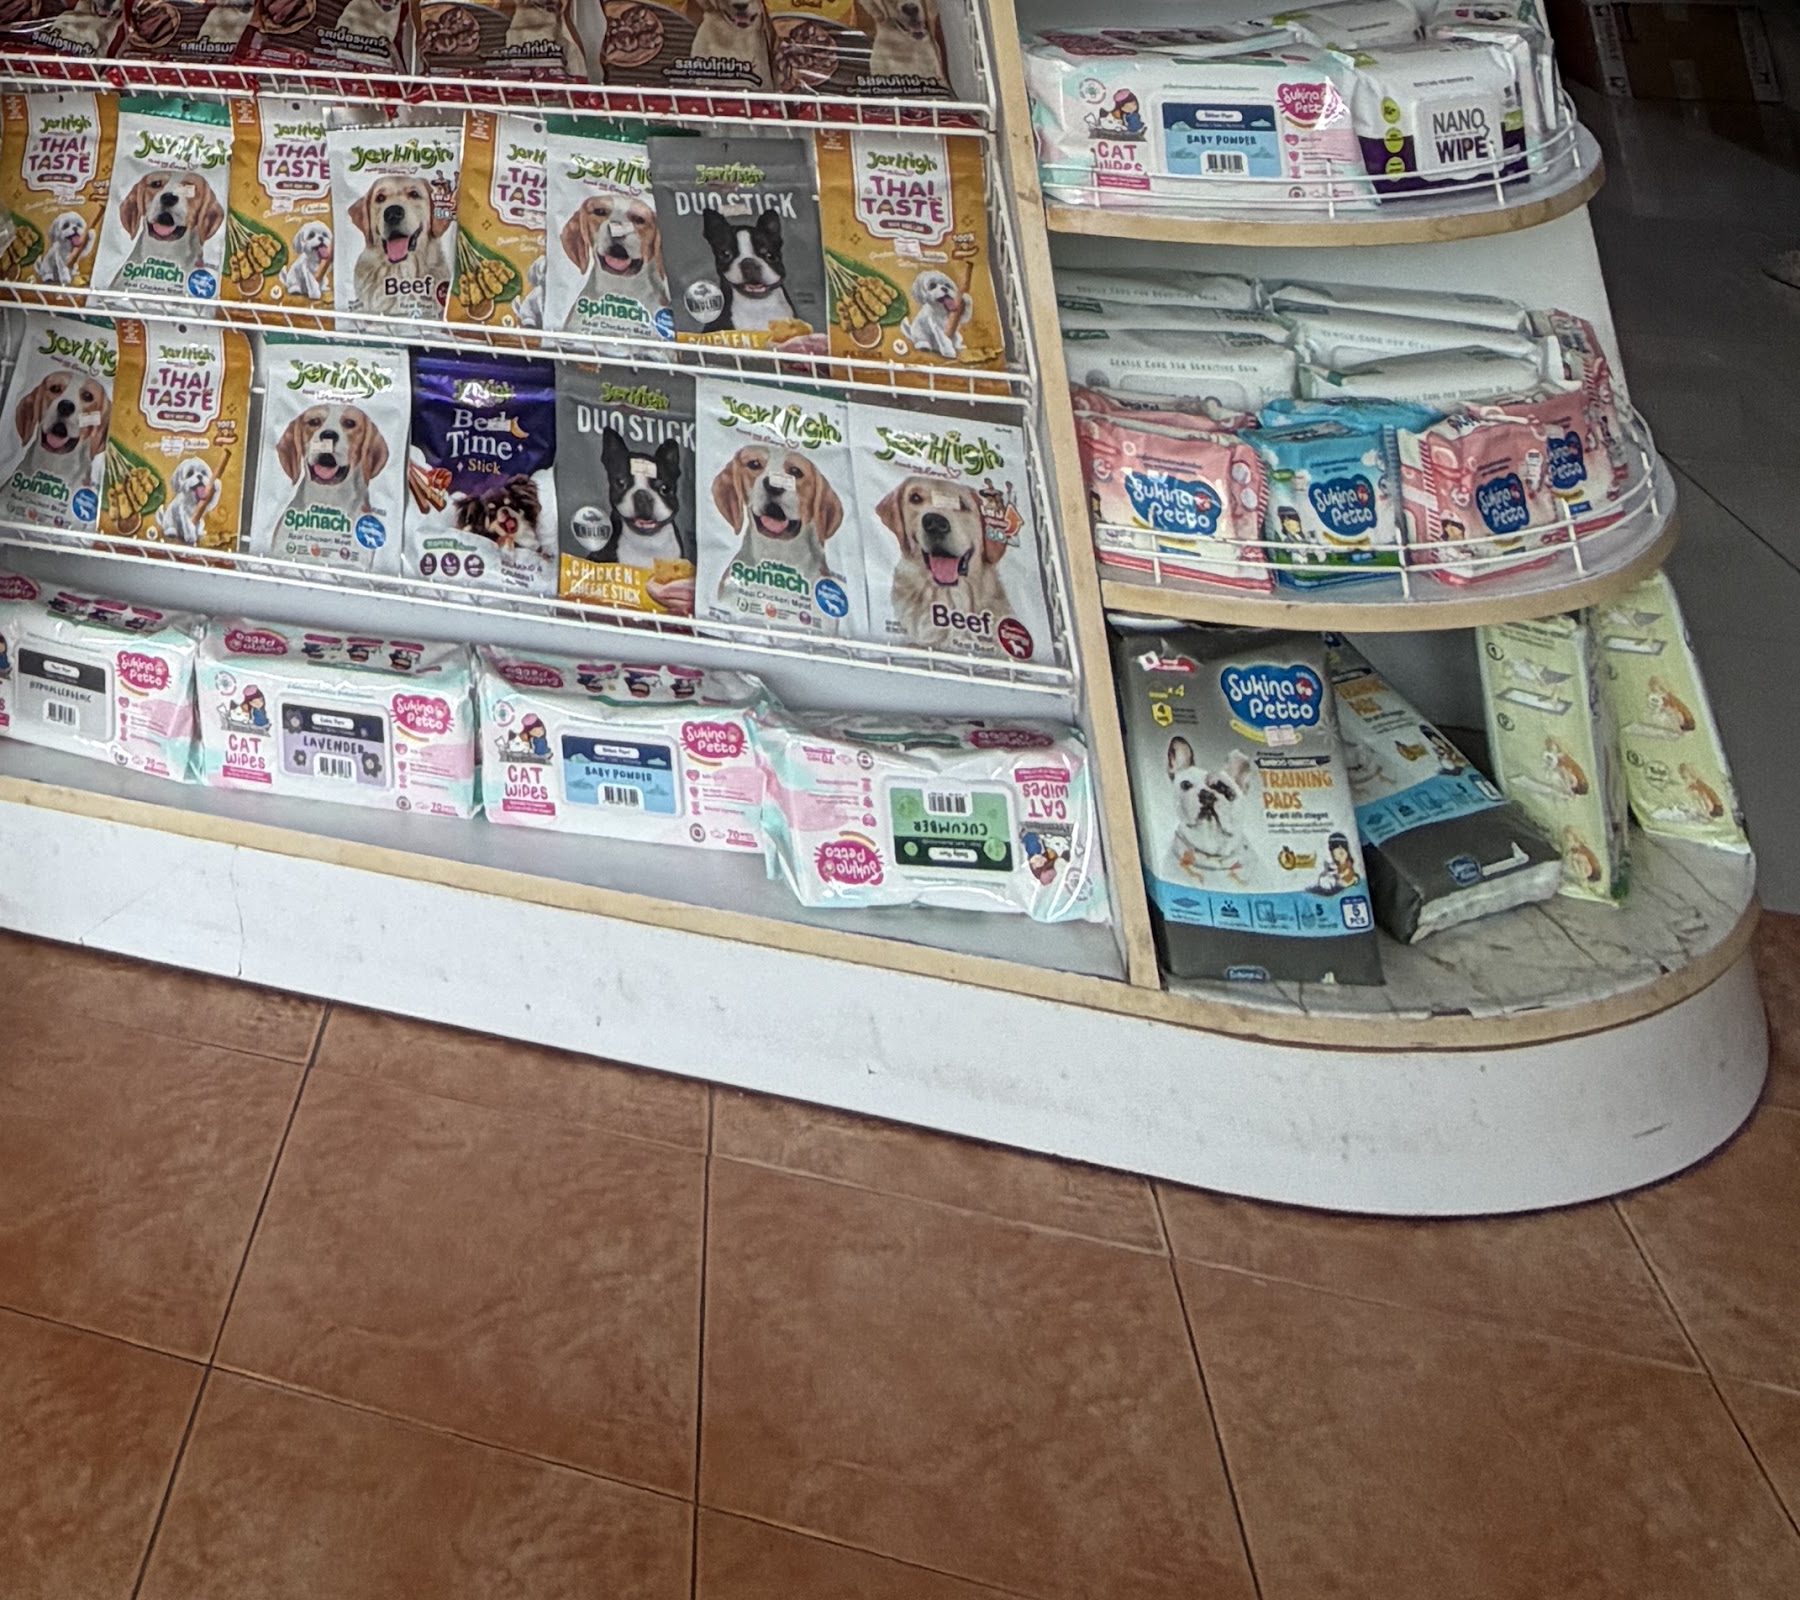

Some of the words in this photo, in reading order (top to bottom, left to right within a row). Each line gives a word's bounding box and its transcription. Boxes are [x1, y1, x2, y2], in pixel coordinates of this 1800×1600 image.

[1281, 87, 1322, 110] Sukina
[1432, 108, 1487, 135] NANO
[38, 137, 86, 154] THAI
[1097, 140, 1138, 161] CAT
[1187, 133, 1217, 146] BABY
[1219, 133, 1258, 147] POWDER
[1435, 134, 1490, 163] WIPE
[29, 152, 91, 174] TASTE
[866, 149, 938, 175] JerHigh
[869, 175, 935, 199] THAI
[675, 190, 722, 217] DUO
[861, 196, 945, 224] TASTE
[122, 261, 184, 283] Spinach
[384, 275, 434, 296] Beef
[576, 298, 650, 323] Spinach
[158, 368, 211, 392] THAI
[146, 388, 214, 410] TASTE
[718, 395, 843, 449] JerHigh
[445, 431, 513, 461] Time
[874, 425, 1004, 475] JerHigh
[467, 459, 502, 475] Stick
[12, 476, 69, 502] Spinach
[1132, 475, 1196, 509] Sukina
[1313, 484, 1359, 512] Sukina
[1477, 487, 1513, 515] Sukina
[284, 508, 352, 533] Spinach
[1148, 502, 1212, 529] Petto
[1332, 502, 1375, 525] Petto
[1491, 502, 1527, 528] Petto
[731, 560, 810, 594] Spinach
[931, 603, 991, 636] Beef
[119, 651, 156, 674] Sukina
[129, 669, 164, 688] Petto
[1227, 671, 1297, 702] Sukina
[394, 700, 435, 720] Sukina
[1249, 696, 1315, 722] Petto
[410, 714, 445, 734] Petto
[685, 725, 728, 743] Sukina
[228, 734, 261, 755] CAT
[303, 734, 366, 755] LAVENDER
[696, 739, 739, 756] Petto
[508, 764, 543, 785] CAT
[1259, 768, 1333, 792] TRAINING
[1028, 800, 1068, 820] CAT
[1262, 791, 1304, 811] PADS
[913, 818, 990, 836] CUCUMBER
